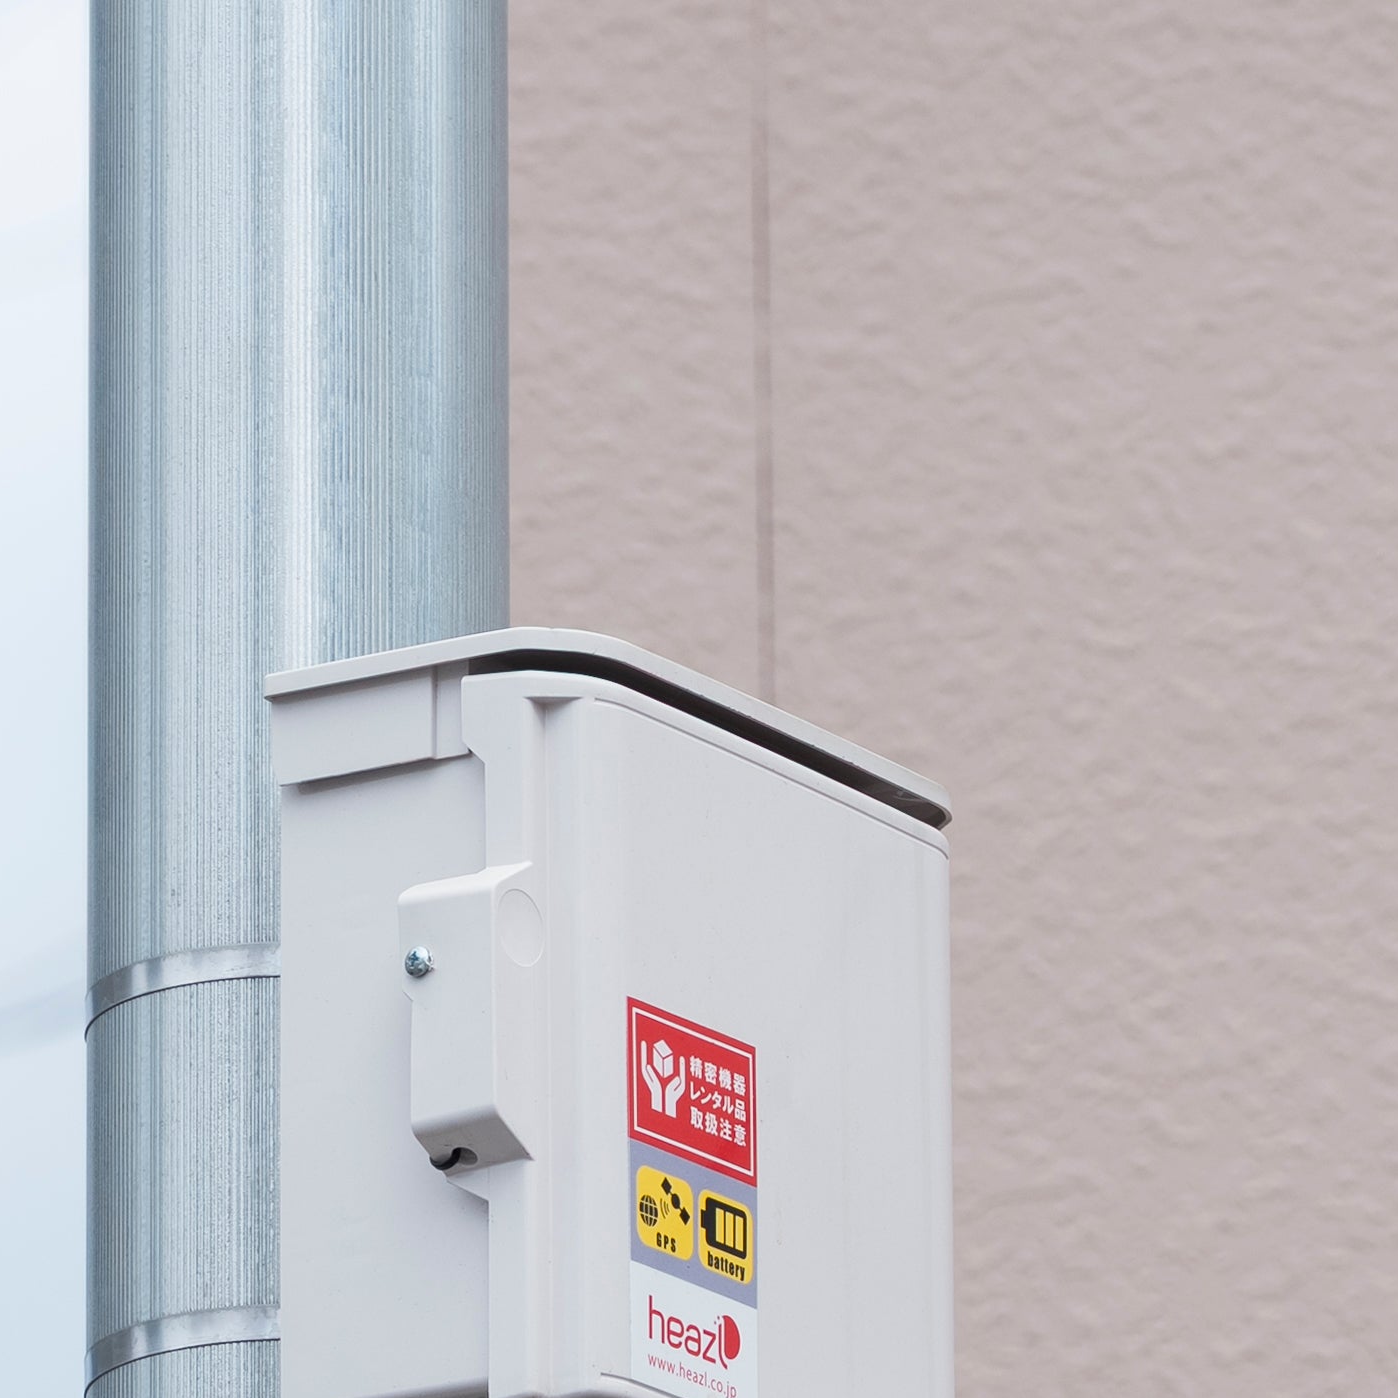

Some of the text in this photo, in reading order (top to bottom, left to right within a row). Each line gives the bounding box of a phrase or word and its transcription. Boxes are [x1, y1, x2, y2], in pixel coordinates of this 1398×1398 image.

[690, 1056, 746, 1096] 精密機器
[690, 1081, 746, 1122] レンタル品
[690, 1106, 746, 1147] 取扱注意
[656, 1232, 677, 1253] GPS
[707, 1251, 746, 1282] battery
